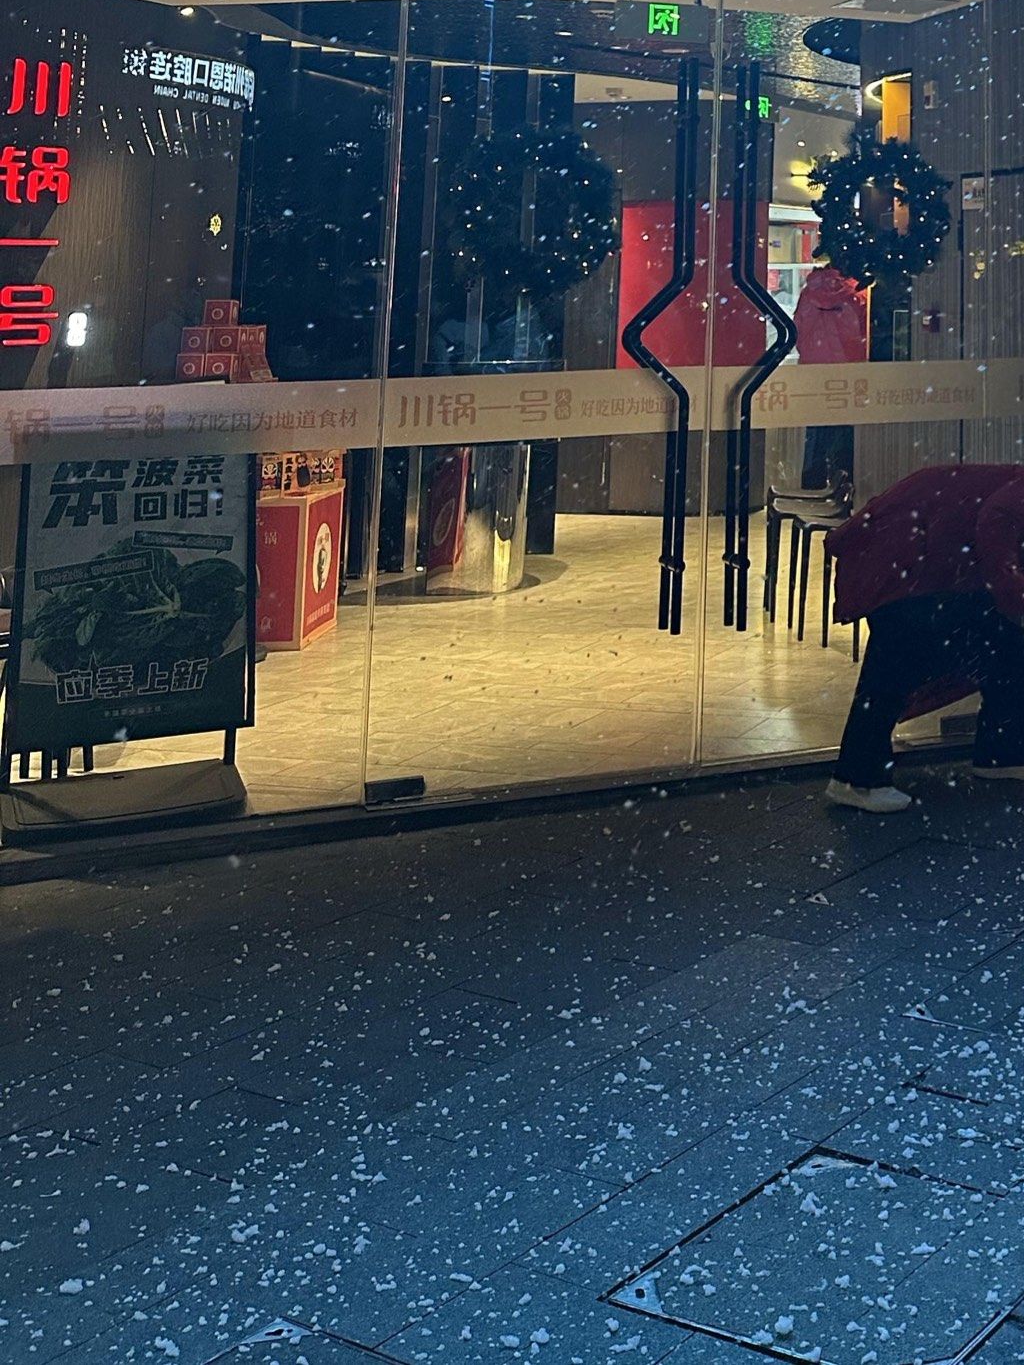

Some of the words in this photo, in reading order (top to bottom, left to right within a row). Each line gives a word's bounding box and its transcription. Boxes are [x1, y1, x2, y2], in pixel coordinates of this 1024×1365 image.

[0, 57, 72, 347] 川锅一号
[186, 408, 359, 434] 好吃因为地道食材
[398, 389, 551, 427] 川锅一号
[579, 394, 698, 420] 好吃因为地道
[56, 658, 209, 705] 应季上新
